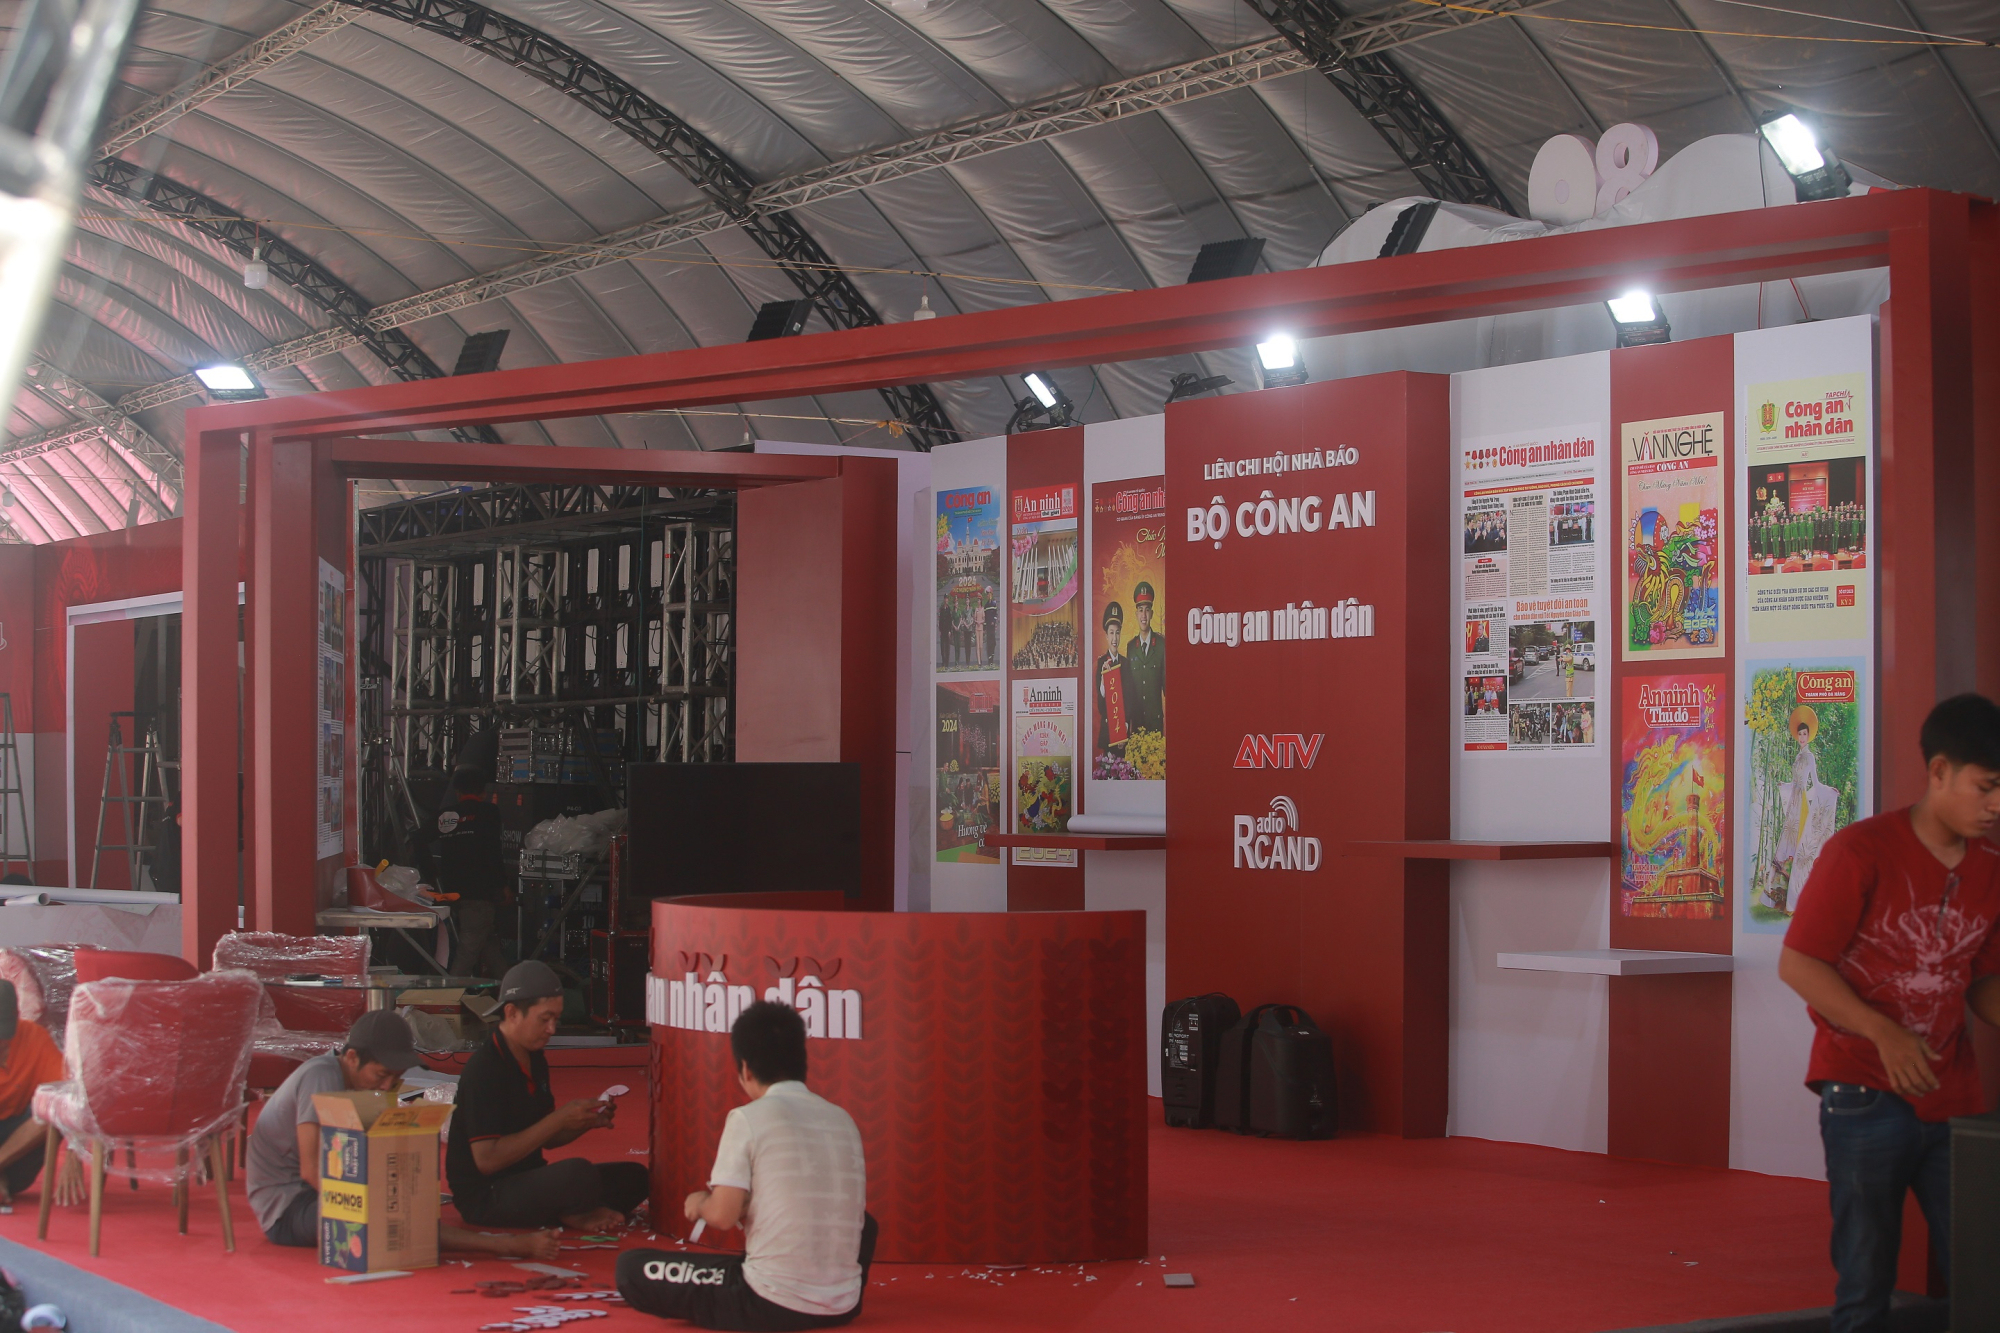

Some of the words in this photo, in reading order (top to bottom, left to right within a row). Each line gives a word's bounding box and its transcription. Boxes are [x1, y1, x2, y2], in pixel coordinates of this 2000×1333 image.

[1785, 401, 1822, 420] Công
[1825, 400, 1843, 414] an
[1785, 421, 1822, 438] nhân
[1825, 418, 1853, 435] dân
[1204, 458, 1235, 480] LIÊN
[1236, 458, 1261, 476] CHI
[1263, 451, 1289, 477] HỘI
[1292, 447, 1325, 471] NHÀ
[1326, 444, 1359, 467] BÁO
[1500, 446, 1526, 467] Công
[1529, 447, 1542, 462] an
[1544, 440, 1571, 461] nhân
[1573, 437, 1594, 458] dân
[1657, 460, 1676, 472] CÔNG
[1678, 461, 1688, 469] AN
[945, 491, 975, 509] Công
[977, 491, 991, 504] an
[1023, 497, 1037, 512] An
[1040, 492, 1060, 510] ninh
[1116, 491, 1138, 513] Công
[1140, 492, 1151, 510] an
[1152, 487, 1165, 508] nh
[1188, 495, 1230, 549] BỘ
[1236, 490, 1322, 538] CÔNG
[1328, 491, 1375, 530] AN
[959, 576, 976, 587] 2024
[1188, 606, 1241, 647] Công
[1243, 610, 1270, 642] an
[1273, 601, 1328, 640] nhân
[1331, 597, 1374, 638] dân
[1684, 619, 1716, 629] 2024
[1800, 674, 1834, 691] Công
[1835, 677, 1851, 688] an
[942, 720, 957, 732] 2024
[1233, 734, 1325, 769] ANTV
